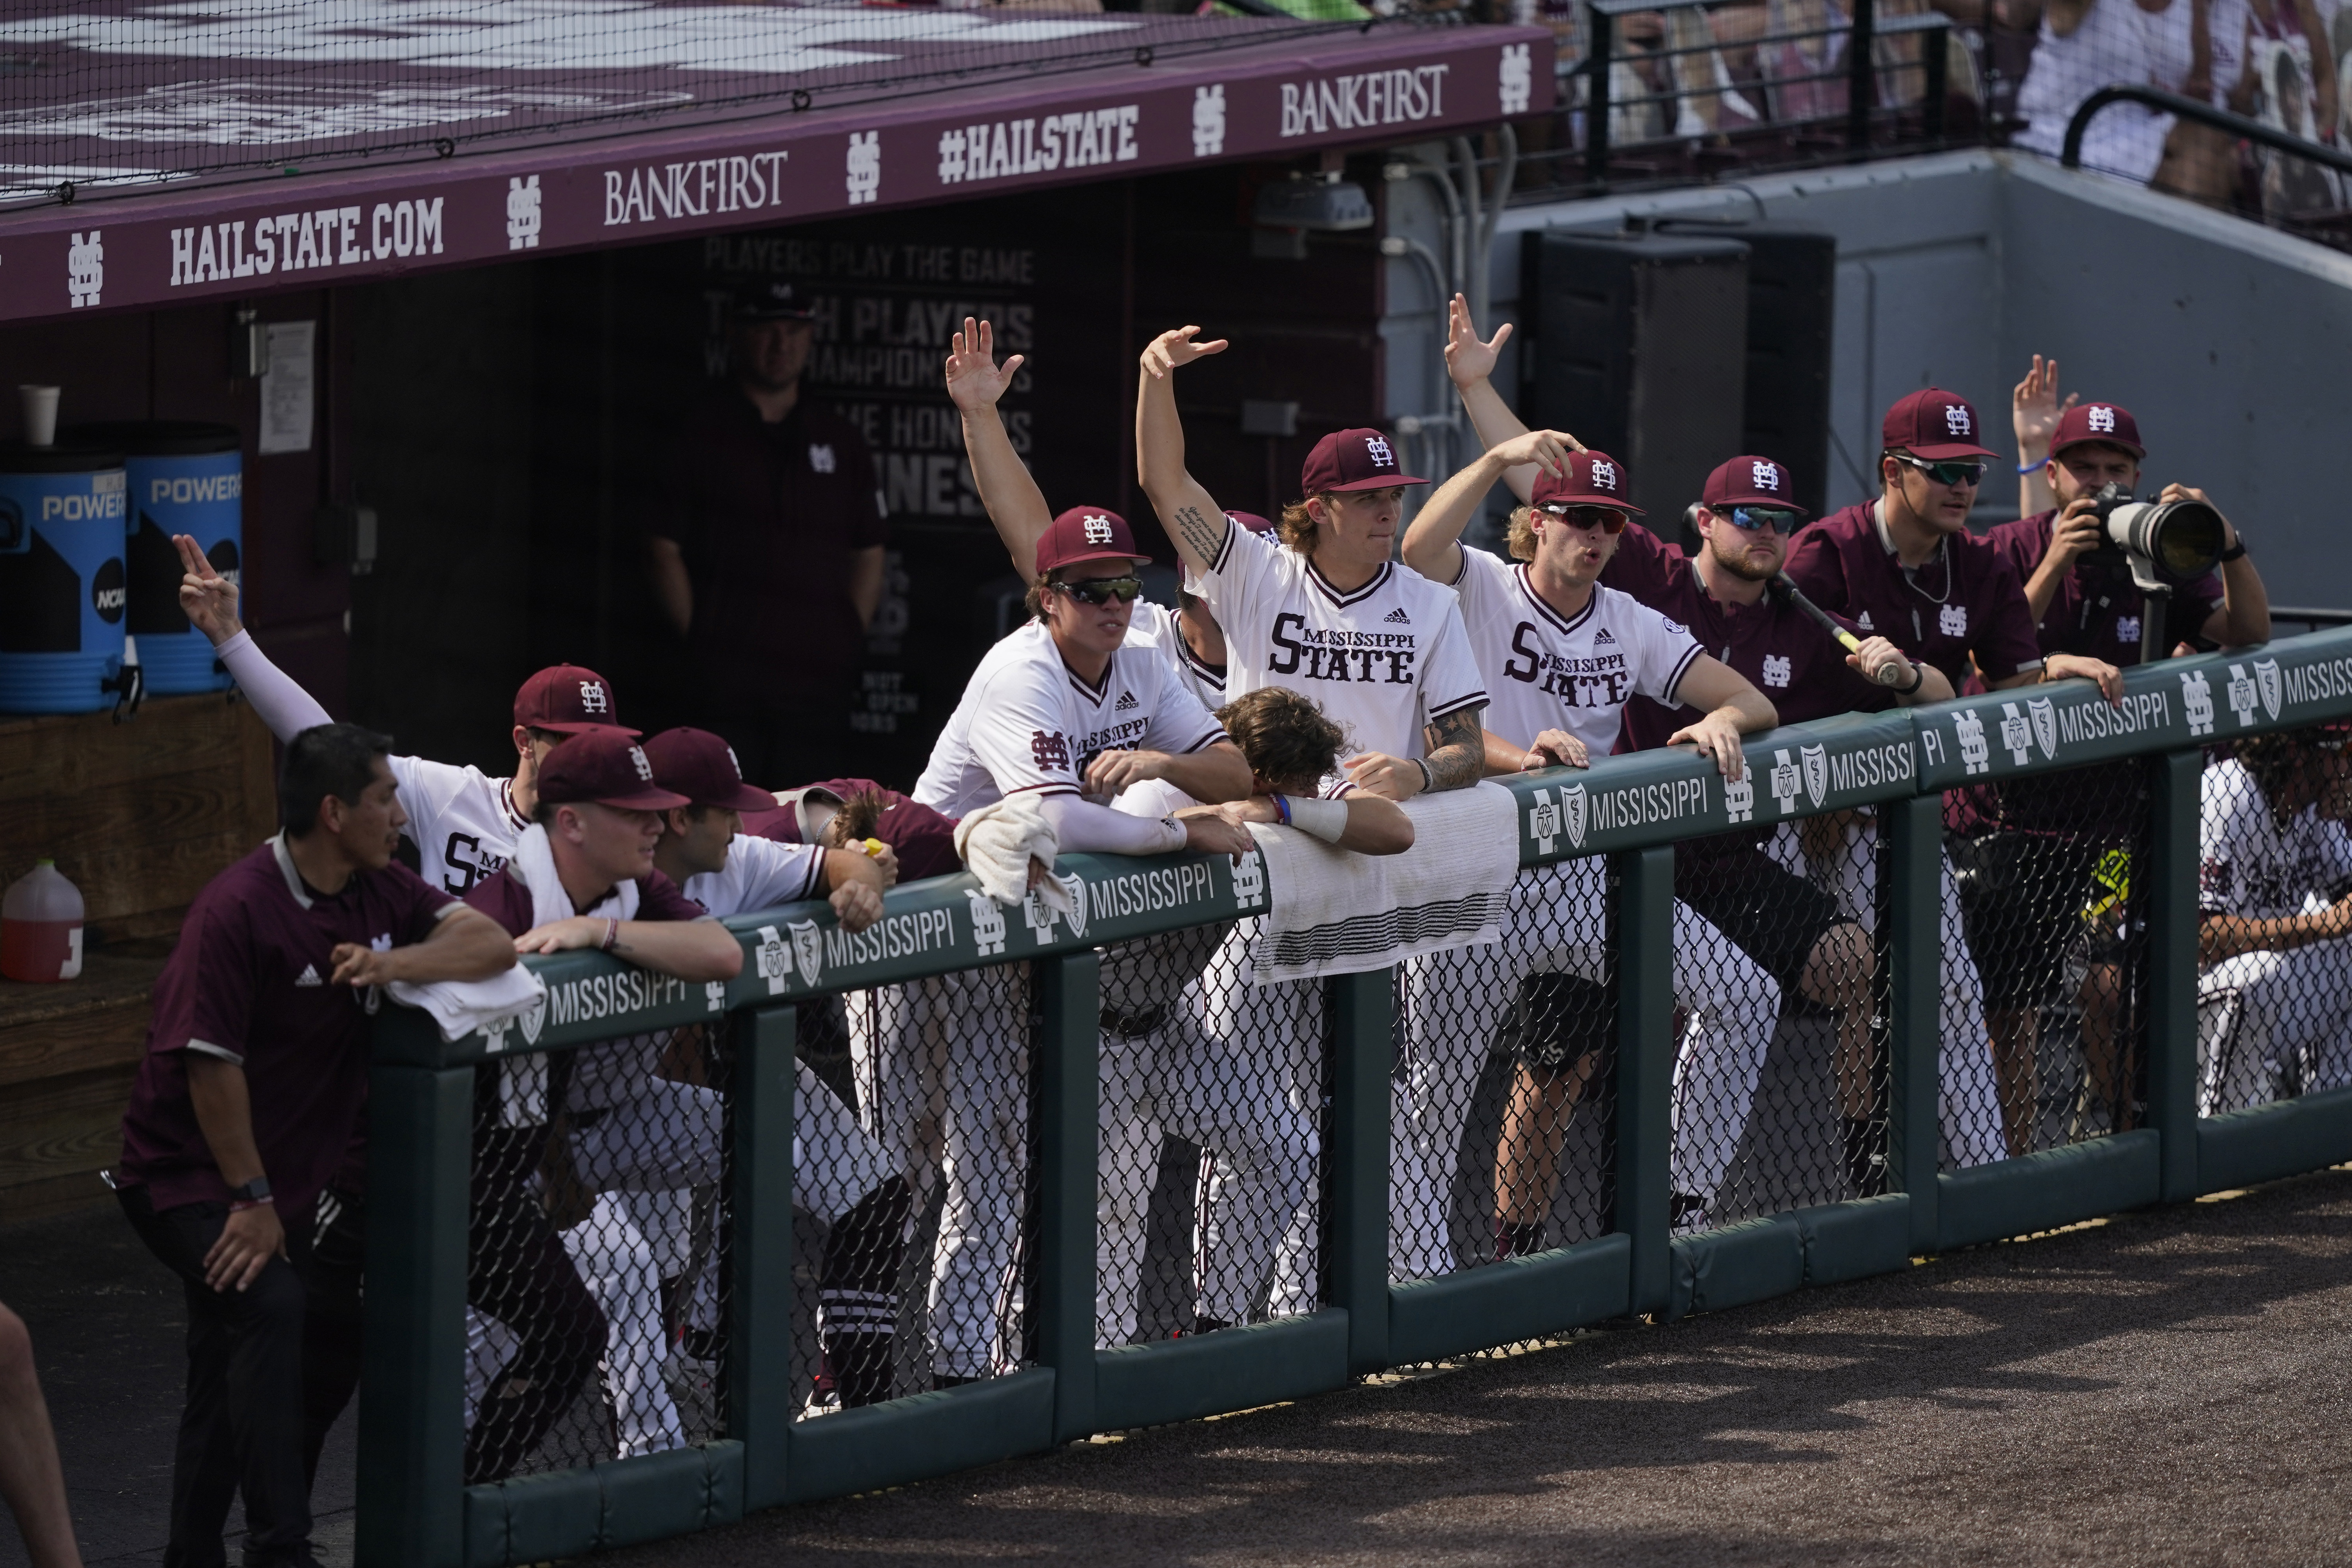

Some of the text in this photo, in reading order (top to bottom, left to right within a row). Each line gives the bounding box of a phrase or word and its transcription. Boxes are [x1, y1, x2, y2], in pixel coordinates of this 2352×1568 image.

[1279, 64, 1448, 137] BANKFIRST
[939, 105, 1138, 184] #HAILSTATE
[604, 151, 788, 225] BANKFIRST
[171, 197, 443, 286] HAILSTATE.COM
[705, 237, 1035, 285] PLAYERS PLAY THE GAME
[1303, 629, 1415, 648] MISSISSIPPI
[1384, 616, 1410, 624] adidas
[1115, 701, 1139, 711] adidas
[2058, 691, 2170, 744] MISSISSIPPI
[1593, 777, 1707, 831] MISSISSIPPI
[1090, 861, 1214, 920] MISSISSIPPI
[826, 908, 954, 968] MISSISSIPPI
[551, 974, 685, 1026] MISSISSIPPI
